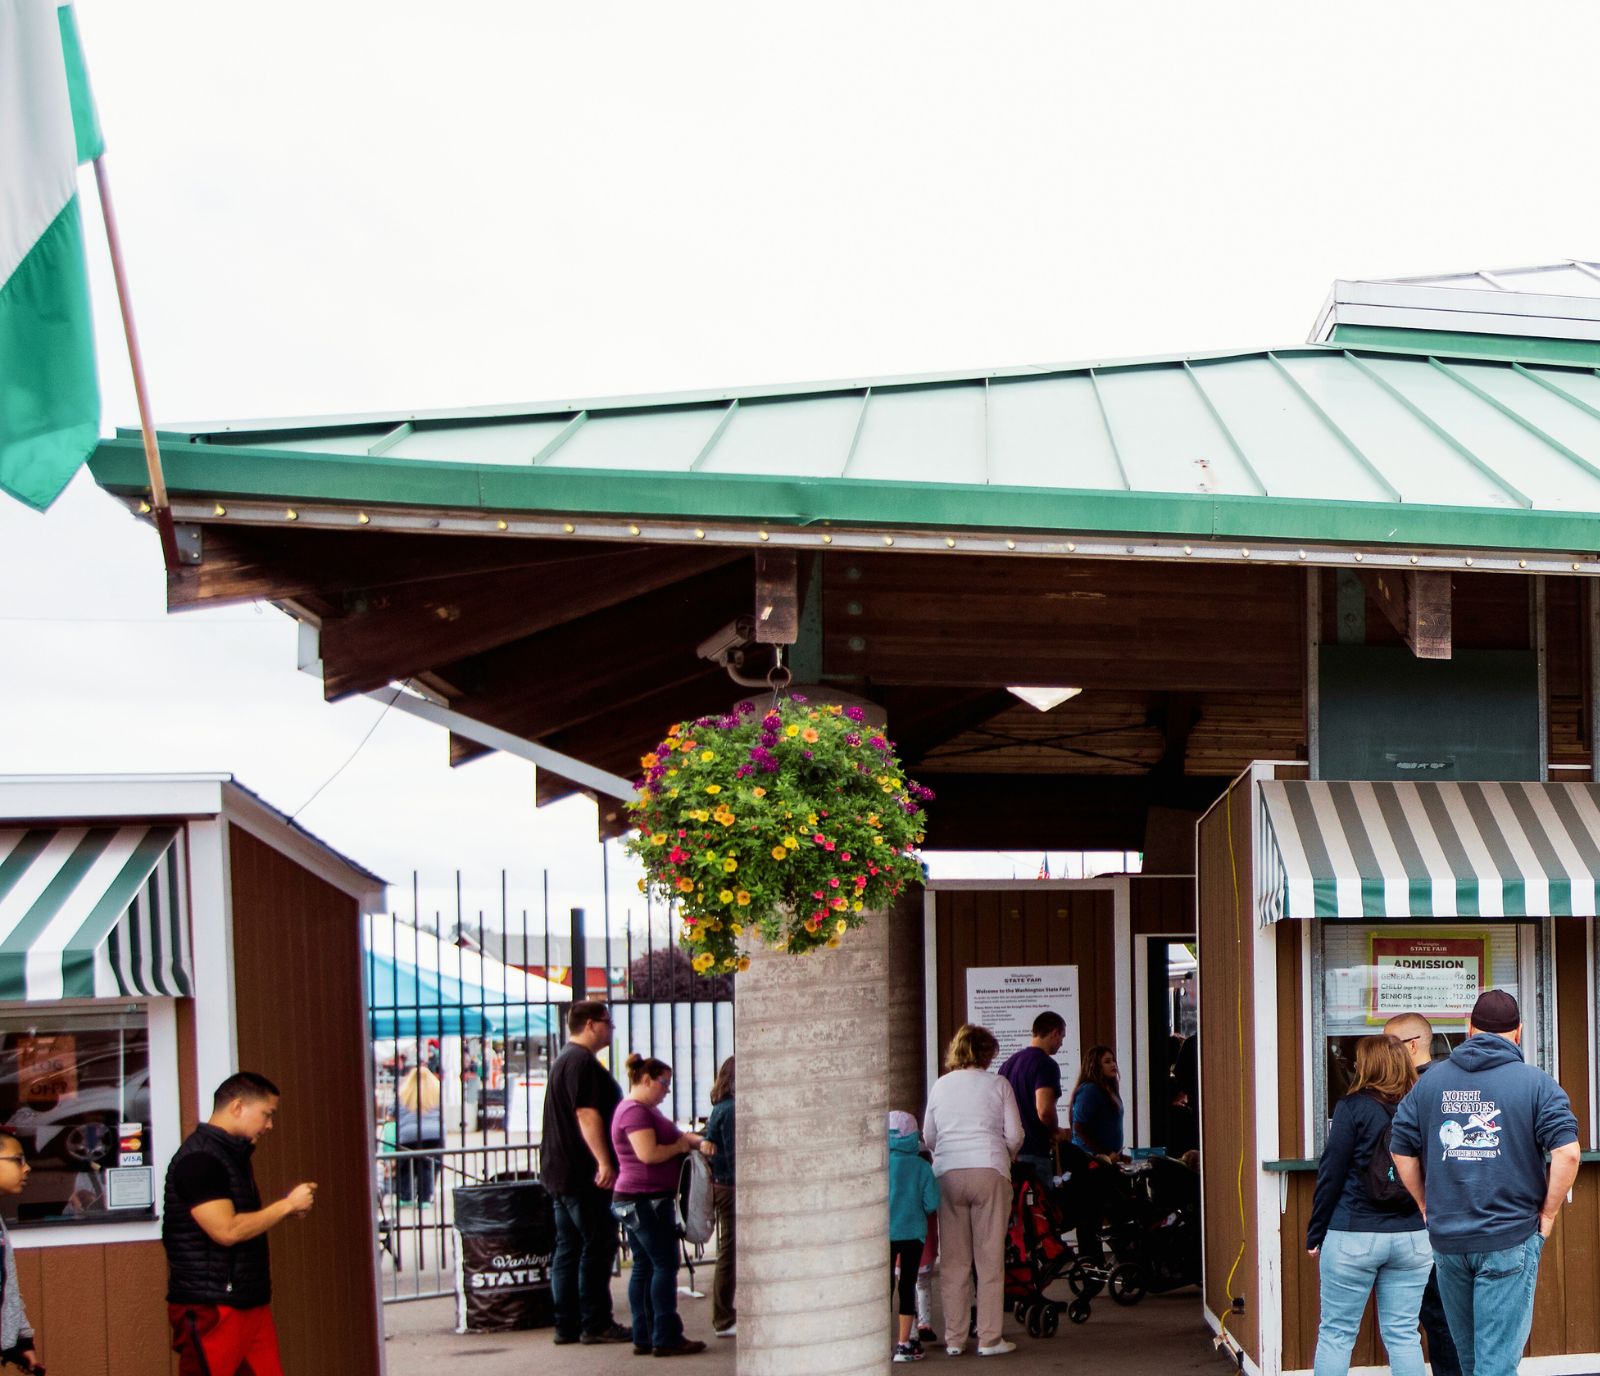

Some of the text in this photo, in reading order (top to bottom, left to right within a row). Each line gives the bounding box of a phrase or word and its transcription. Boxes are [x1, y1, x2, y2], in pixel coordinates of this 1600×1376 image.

[1394, 960, 1464, 969] ADMISSION
[1443, 1090, 1481, 1101] NORTH
[1441, 1102, 1494, 1113] CASCADES
[471, 1269, 541, 1288] STATE
